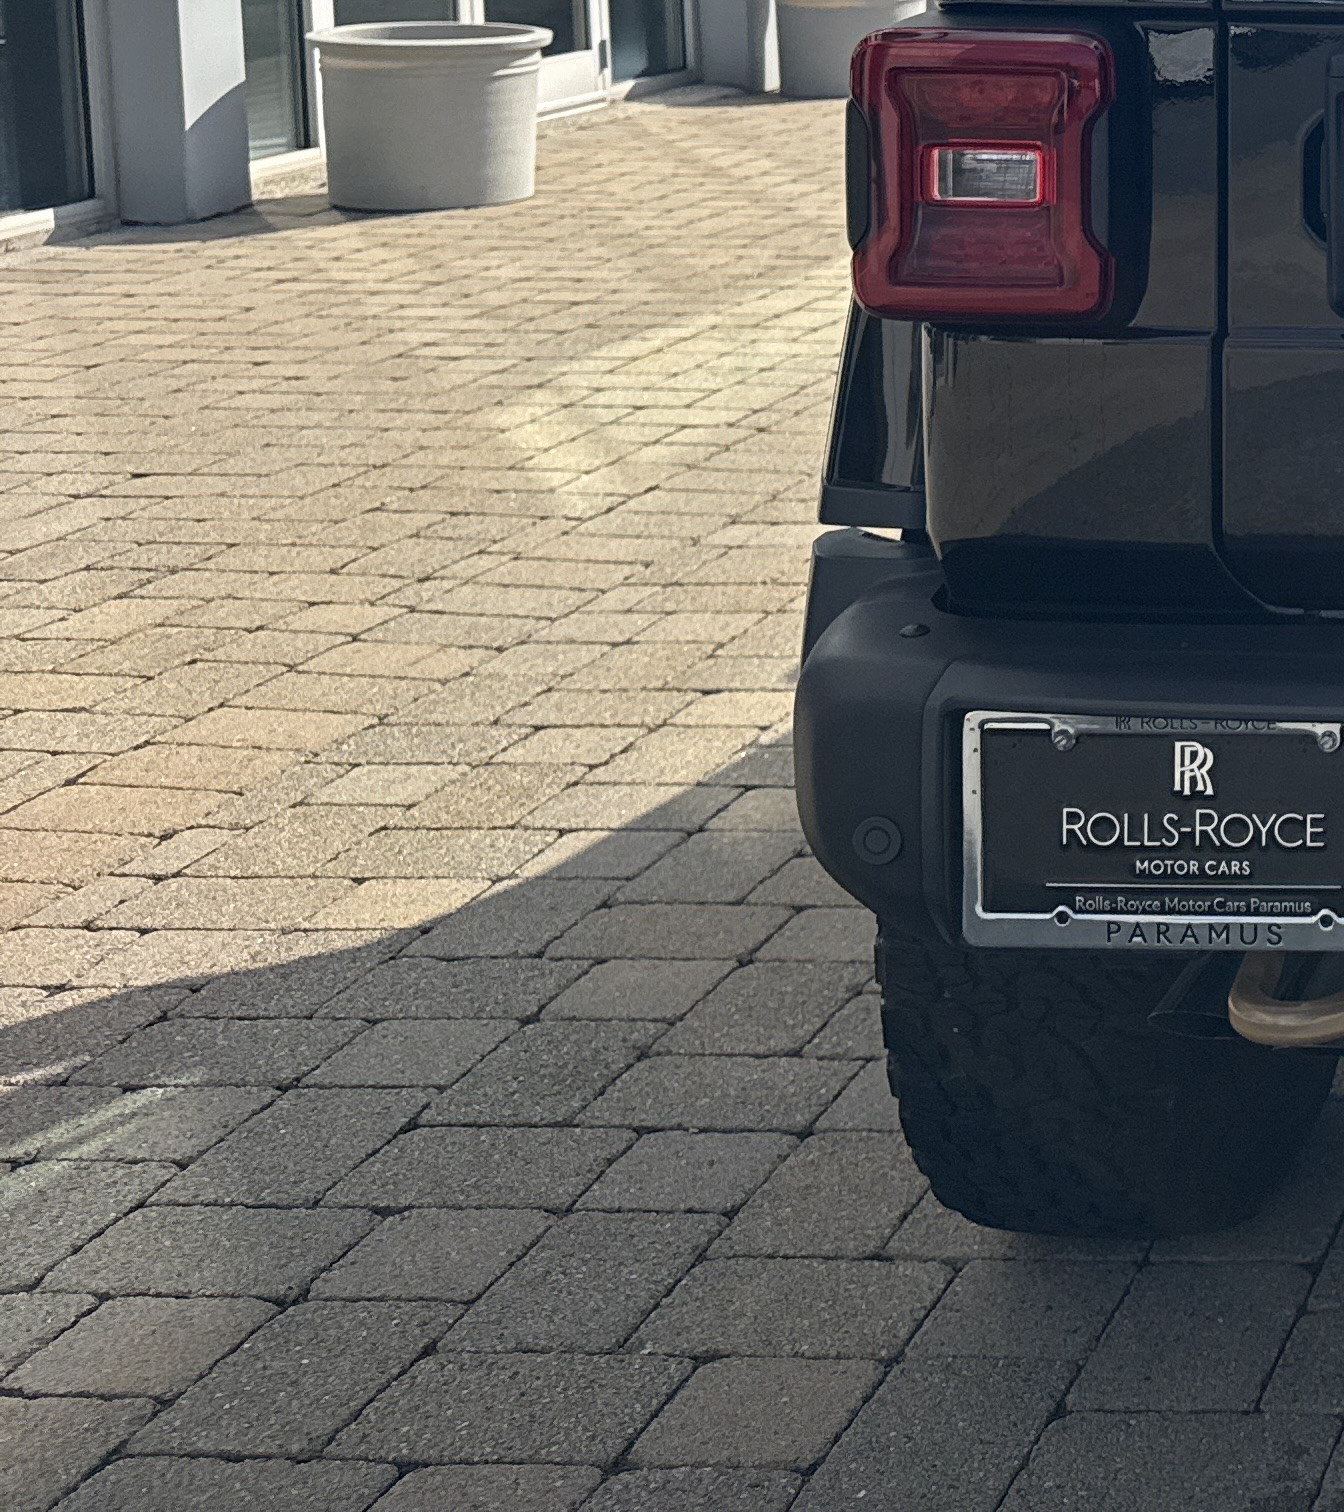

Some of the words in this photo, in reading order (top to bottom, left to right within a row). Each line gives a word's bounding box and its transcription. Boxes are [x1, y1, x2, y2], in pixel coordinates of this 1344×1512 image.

[1173, 741, 1215, 796] RR
[1061, 807, 1325, 848] ROLLS-ROYCE
[1135, 859, 1200, 876] MOTOR
[1204, 860, 1251, 876] CARS
[1075, 895, 1161, 914] Rolls-Royce
[1164, 897, 1209, 912] Motor
[1213, 897, 1247, 913] Cars
[1250, 897, 1312, 913] Paramus
[1105, 921, 1284, 946] PARAMUS
